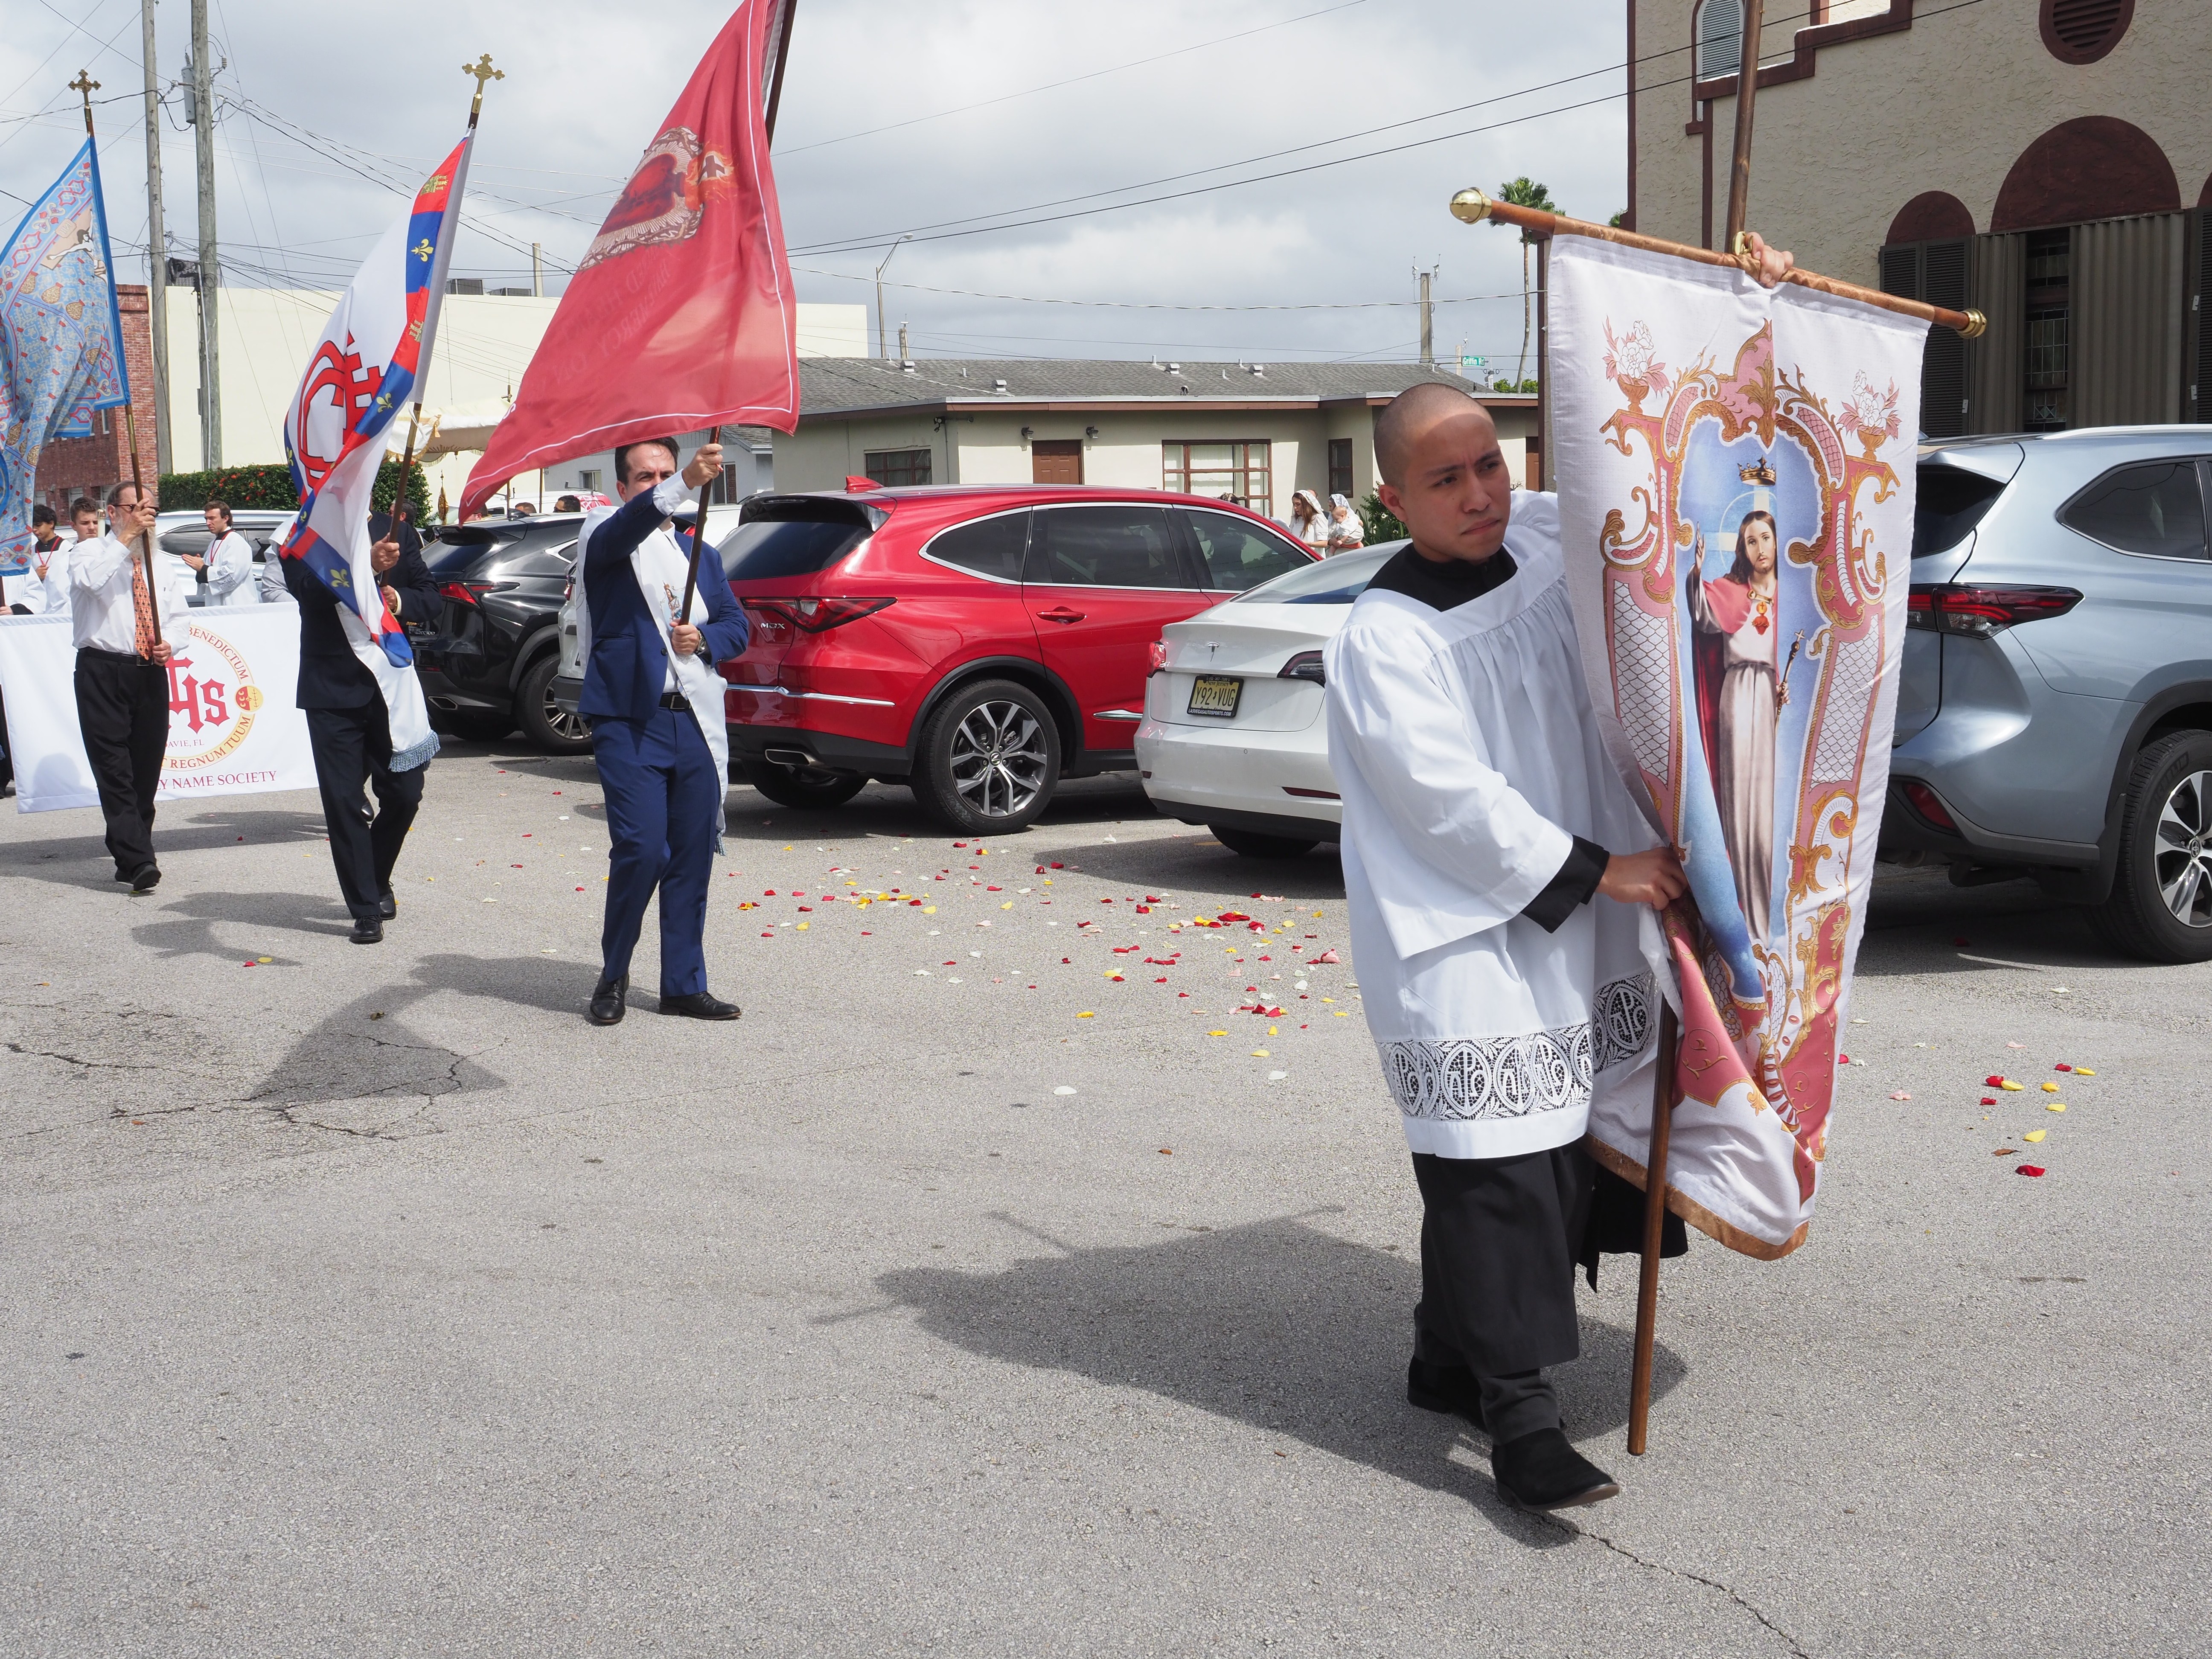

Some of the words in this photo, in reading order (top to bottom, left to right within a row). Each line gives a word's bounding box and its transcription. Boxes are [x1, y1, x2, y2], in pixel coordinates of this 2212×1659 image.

[1463, 357, 1477, 365] Griffin
[1479, 358, 1484, 366] Rd
[189, 626, 249, 679] BENEDICTUM
[171, 747, 227, 768] REGNUM
[224, 716, 251, 749] TUUM
[172, 775, 214, 789] NAME
[218, 771, 277, 786] SOCIETY
